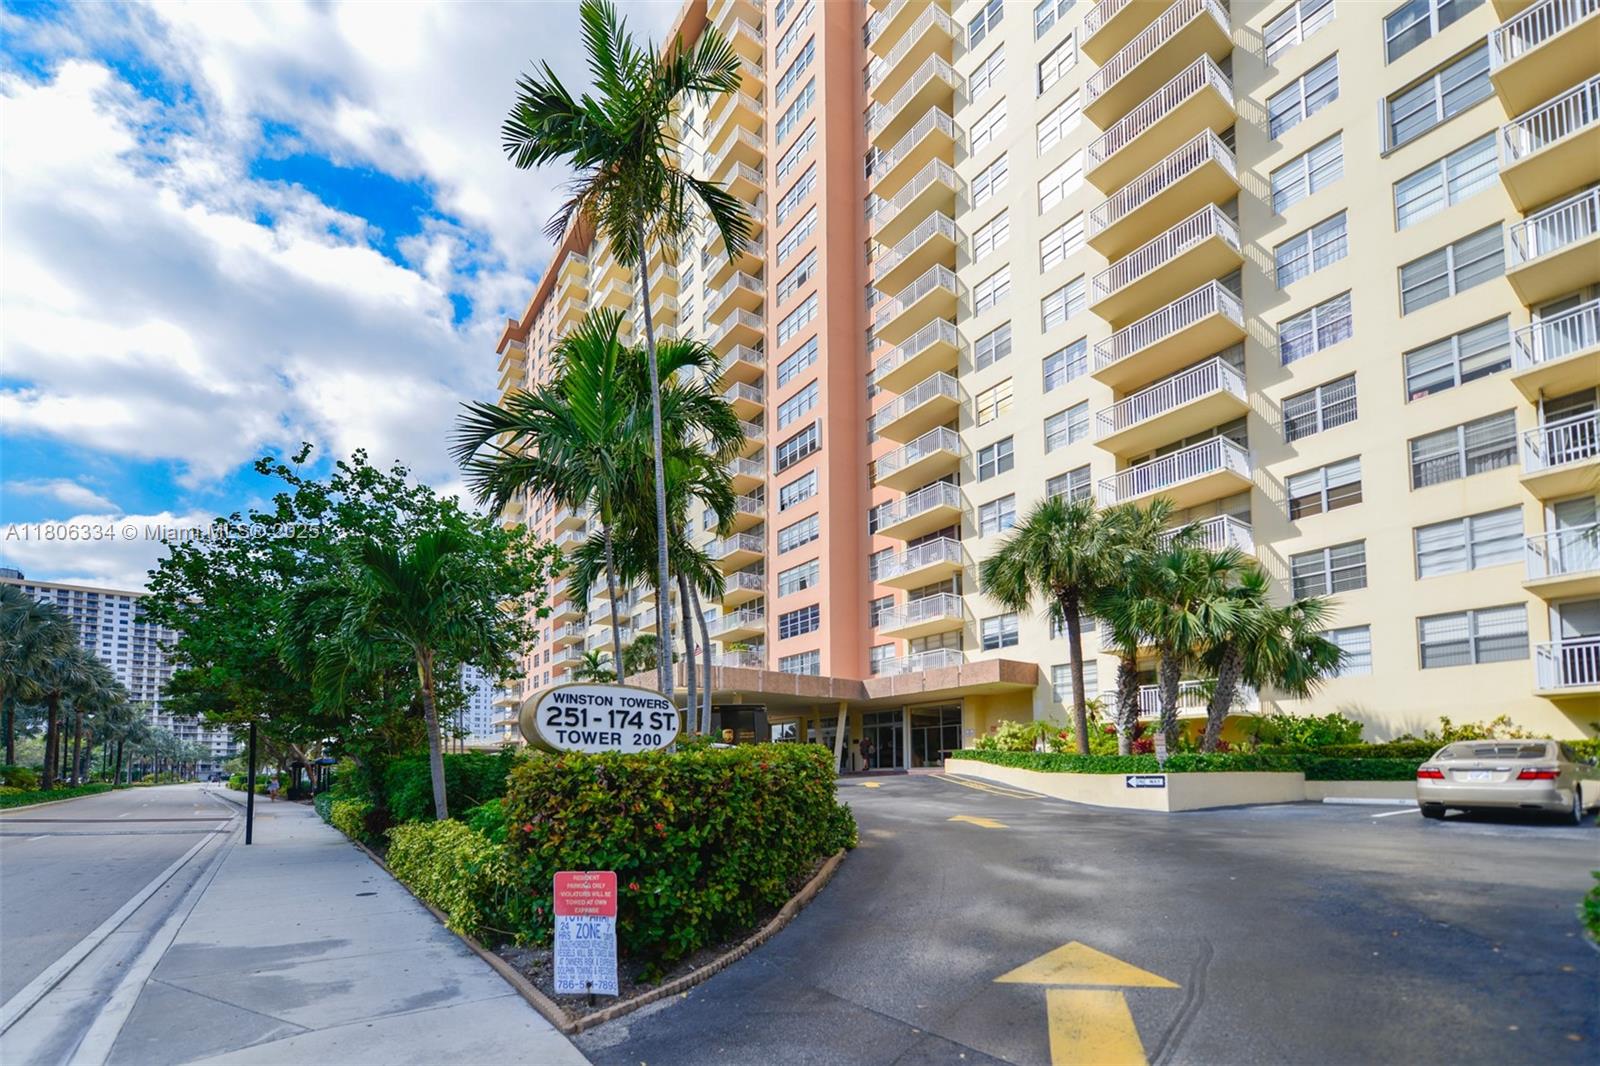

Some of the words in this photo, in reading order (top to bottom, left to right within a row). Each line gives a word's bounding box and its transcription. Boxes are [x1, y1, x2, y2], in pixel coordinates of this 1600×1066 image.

[553, 692, 613, 706] WINSTON
[620, 697, 670, 710] TOWERS
[650, 711, 676, 731] ST.
[556, 730, 622, 745] TOWER
[633, 733, 662, 746] 200
[560, 922, 569, 930] 24
[576, 923, 601, 939] ZONE
[558, 931, 571, 940] HRS
